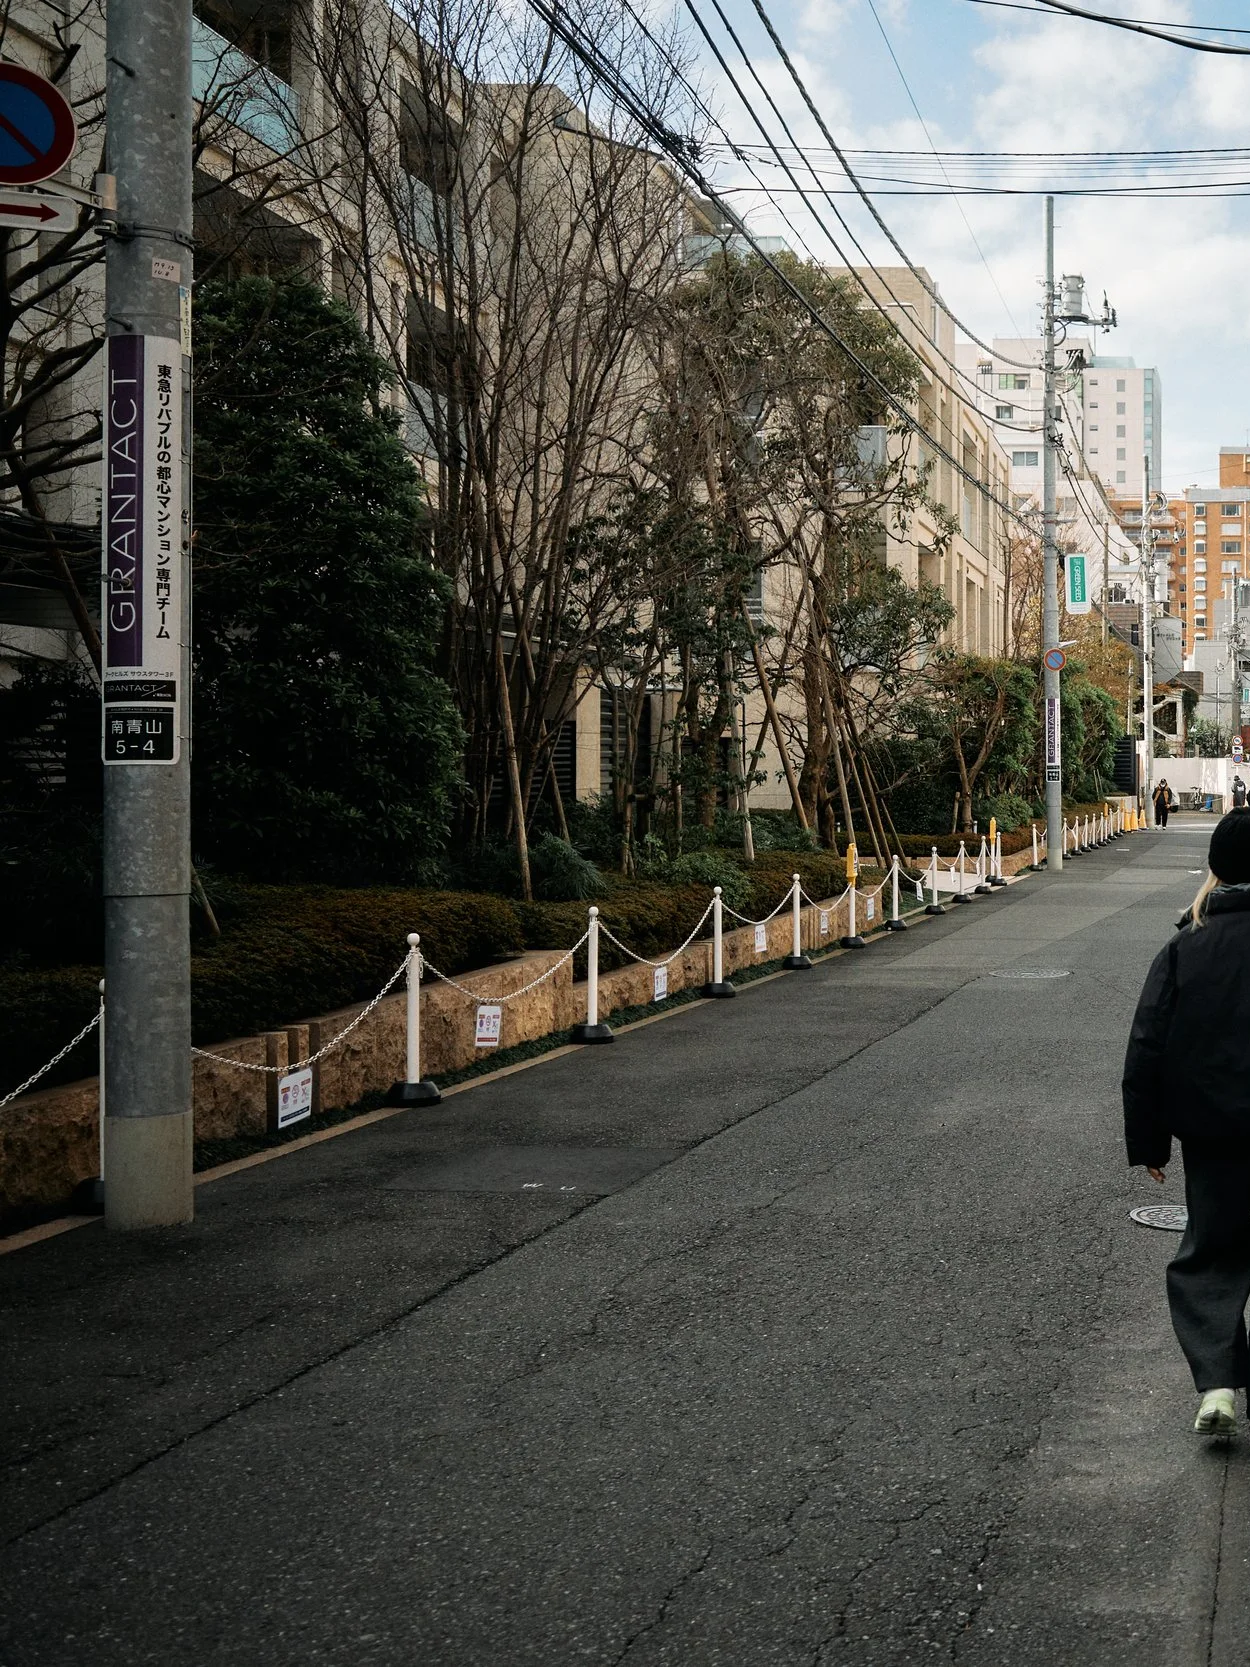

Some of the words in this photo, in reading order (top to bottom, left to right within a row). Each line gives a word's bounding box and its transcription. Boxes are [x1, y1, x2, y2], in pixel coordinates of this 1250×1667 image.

[110, 369, 137, 632] GRANTACT
[106, 684, 156, 693] GRANTACT
[111, 719, 162, 735] 南青山
[115, 740, 156, 754] 5-4
